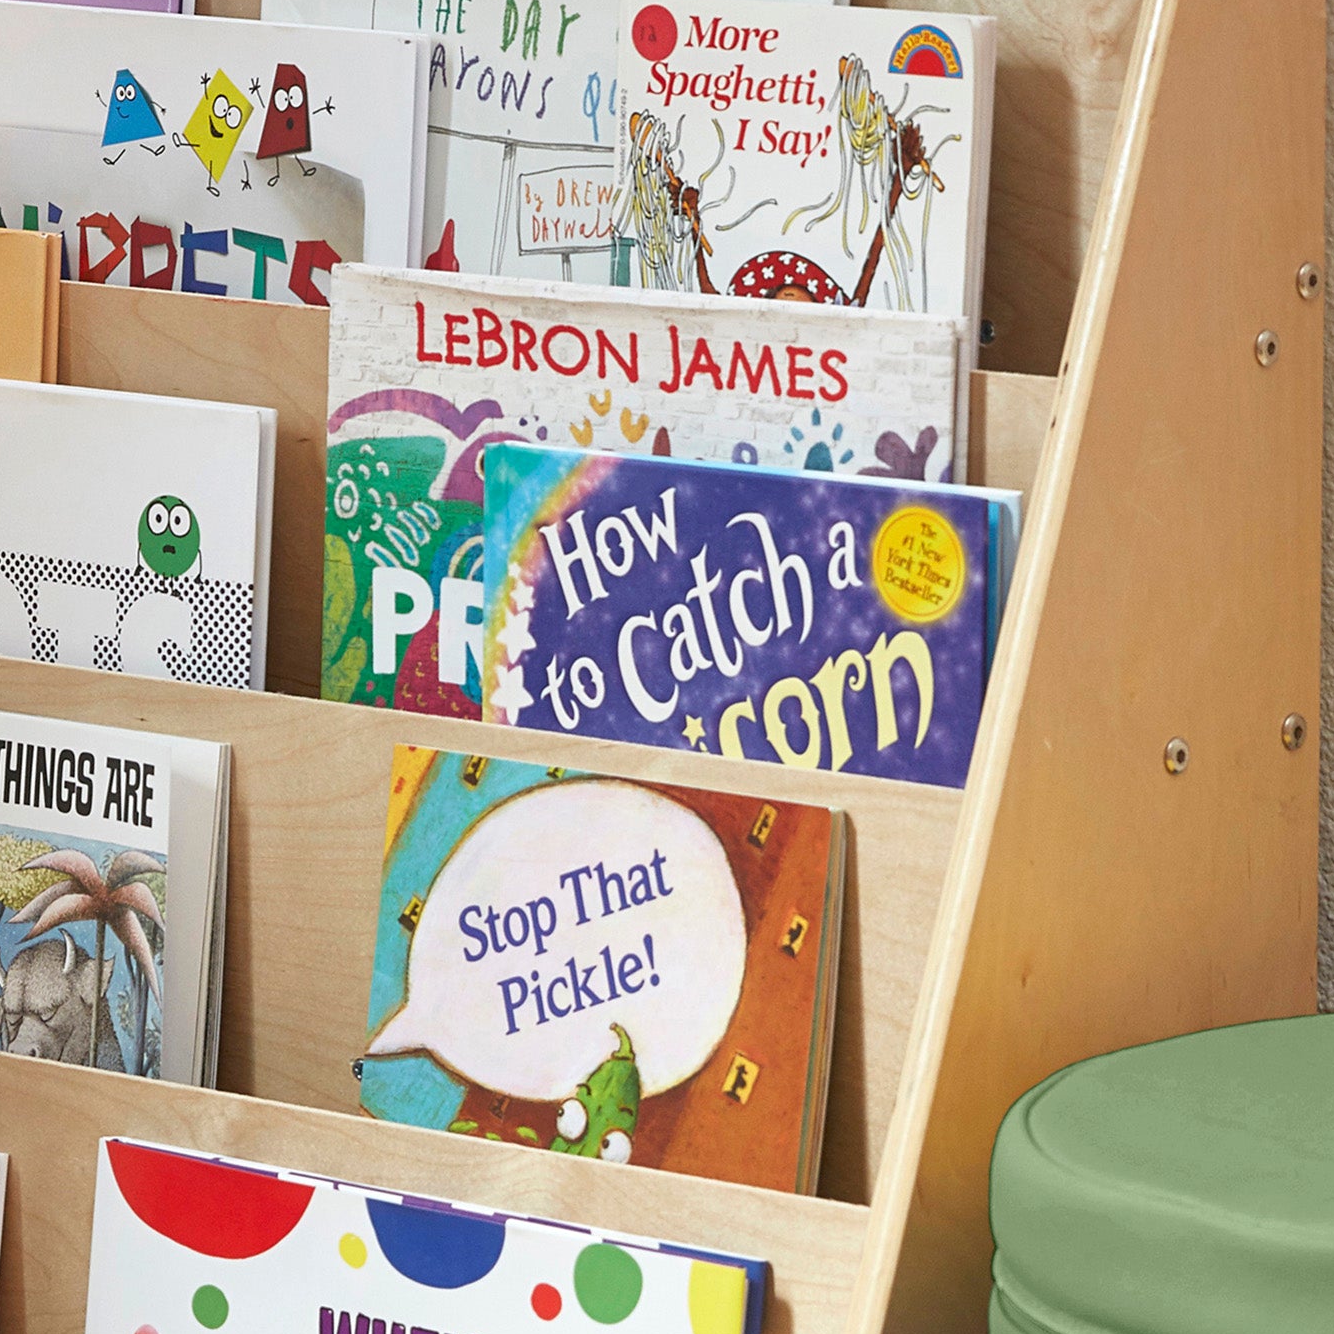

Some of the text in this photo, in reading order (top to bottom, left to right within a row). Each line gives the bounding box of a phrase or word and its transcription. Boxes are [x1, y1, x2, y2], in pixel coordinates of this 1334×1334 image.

[684, 15, 779, 54] More
[646, 60, 826, 115] Spaghetti,
[733, 118, 832, 169] I Say!
[525, 177, 614, 212] By DREW
[659, 324, 849, 402] JAMES
[539, 487, 678, 620] How
[902, 535, 947, 563] #1 New
[920, 522, 937, 539] The
[884, 567, 943, 605] Bestseller
[886, 547, 952, 589] York Times
[540, 512, 864, 730] to Catch a
[103, 756, 155, 828] ARE
[458, 848, 673, 963] Stop That
[497, 933, 662, 1035] Pickle!
